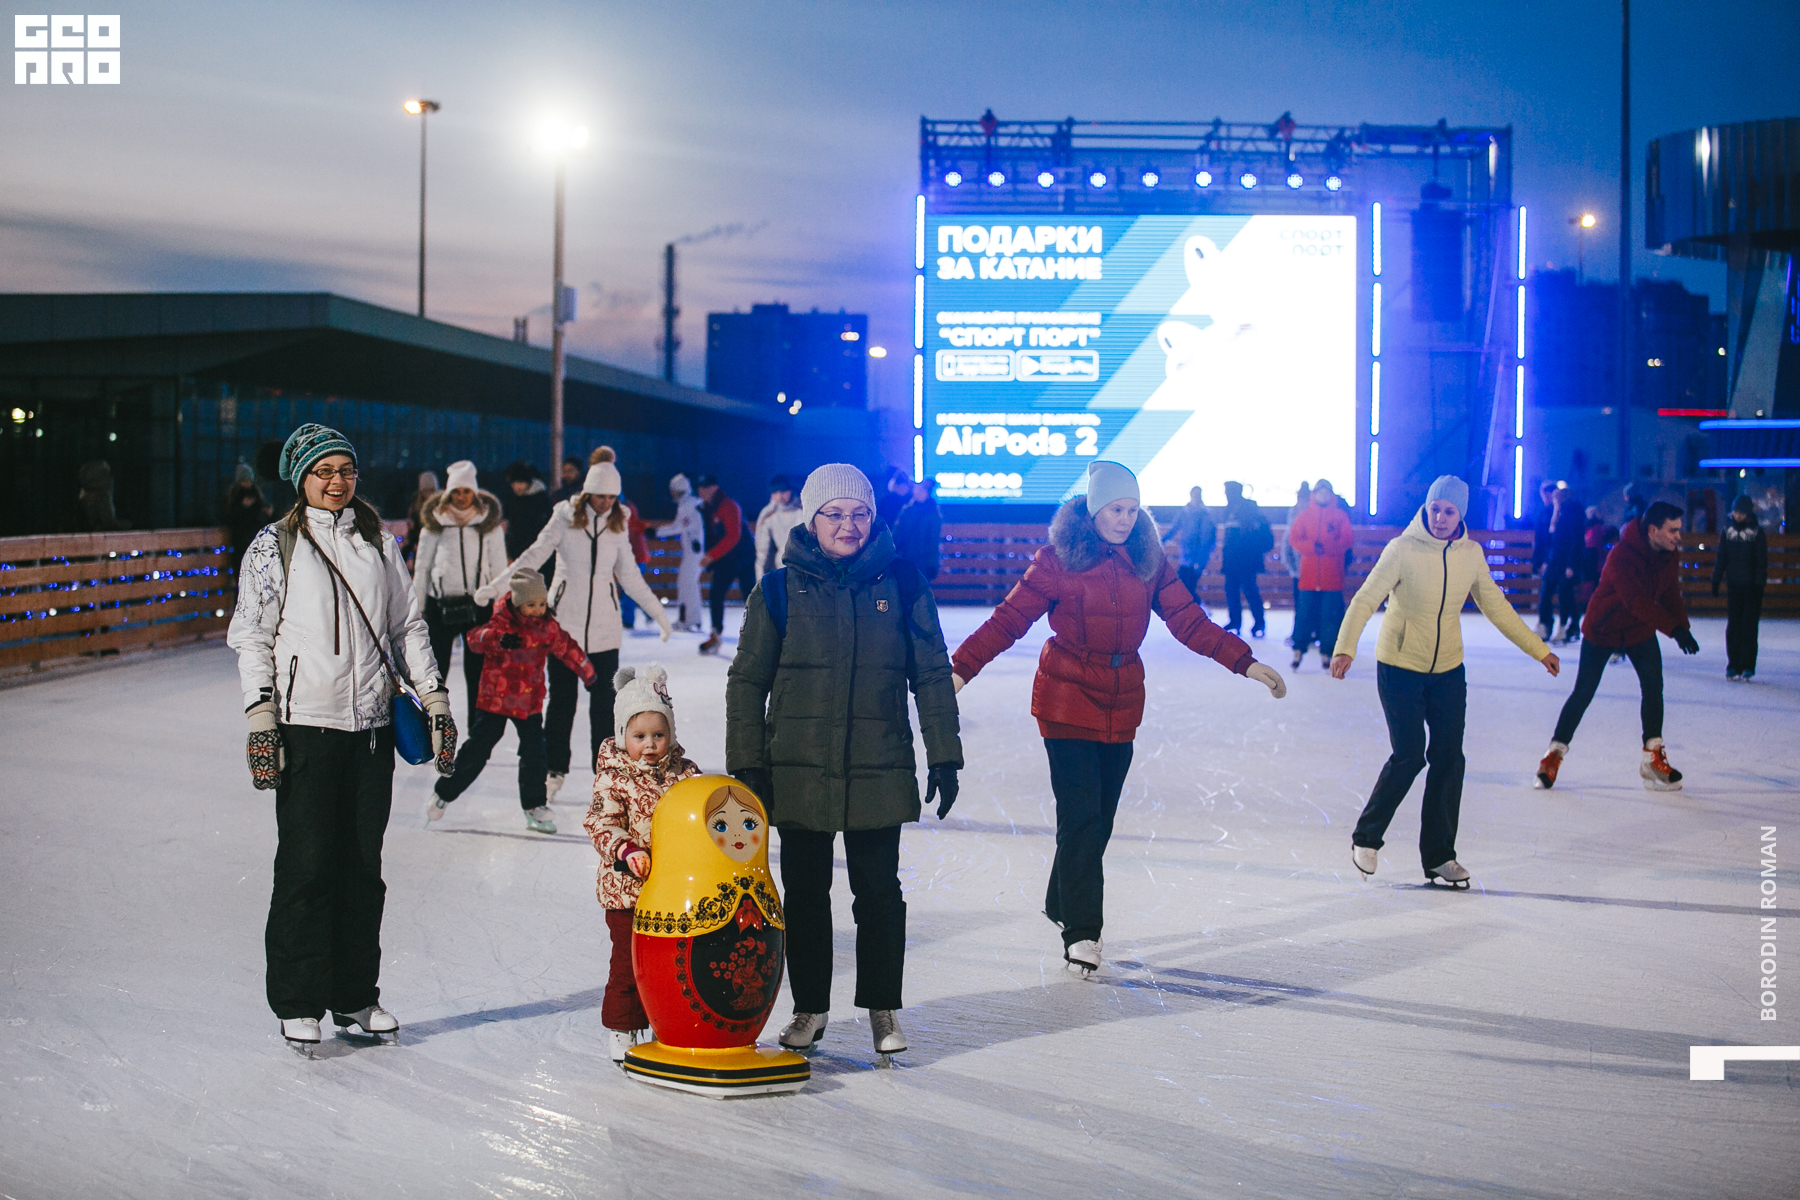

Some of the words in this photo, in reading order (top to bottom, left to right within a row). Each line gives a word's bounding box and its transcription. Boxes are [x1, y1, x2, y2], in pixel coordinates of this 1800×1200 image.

[938, 225, 1102, 257] ПОДАРКИ
[937, 256, 975, 280] ЗА
[980, 256, 1102, 280] КАТАНИЕ
[936, 426, 1067, 456] AirPods
[1075, 426, 1098, 455] 2
